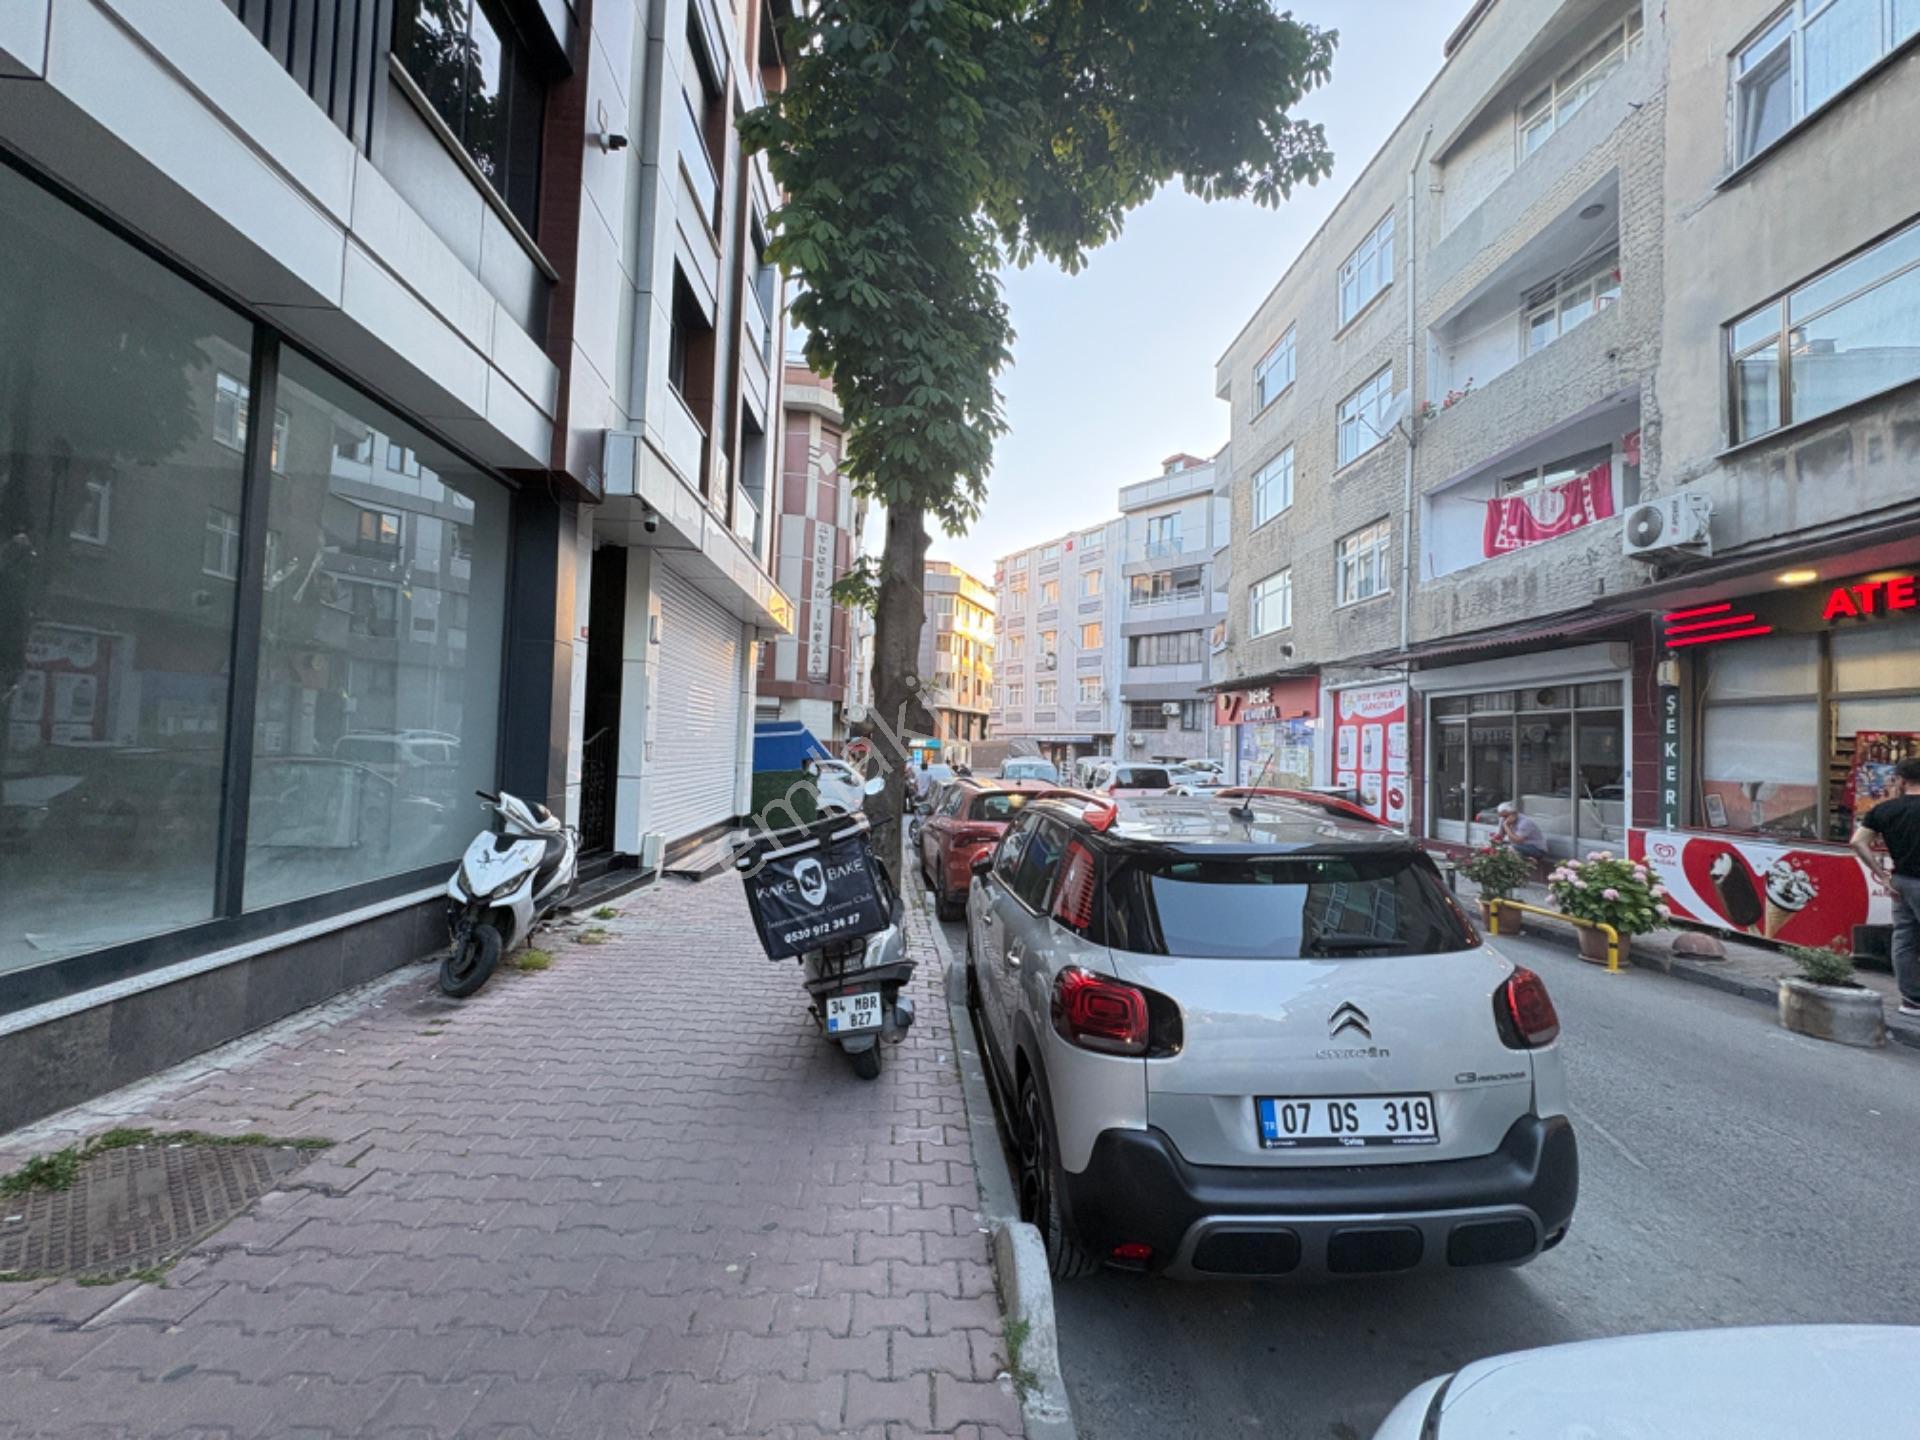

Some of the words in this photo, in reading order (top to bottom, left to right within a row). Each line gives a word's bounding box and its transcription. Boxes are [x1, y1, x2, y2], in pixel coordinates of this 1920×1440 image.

[826, 859, 865, 881] BAKE
[831, 999, 846, 1014] 34
[854, 995, 878, 1011] MBR
[1282, 1102, 1311, 1134] 07
[1327, 1102, 1359, 1133] DS
[1383, 1101, 1430, 1132] 319
